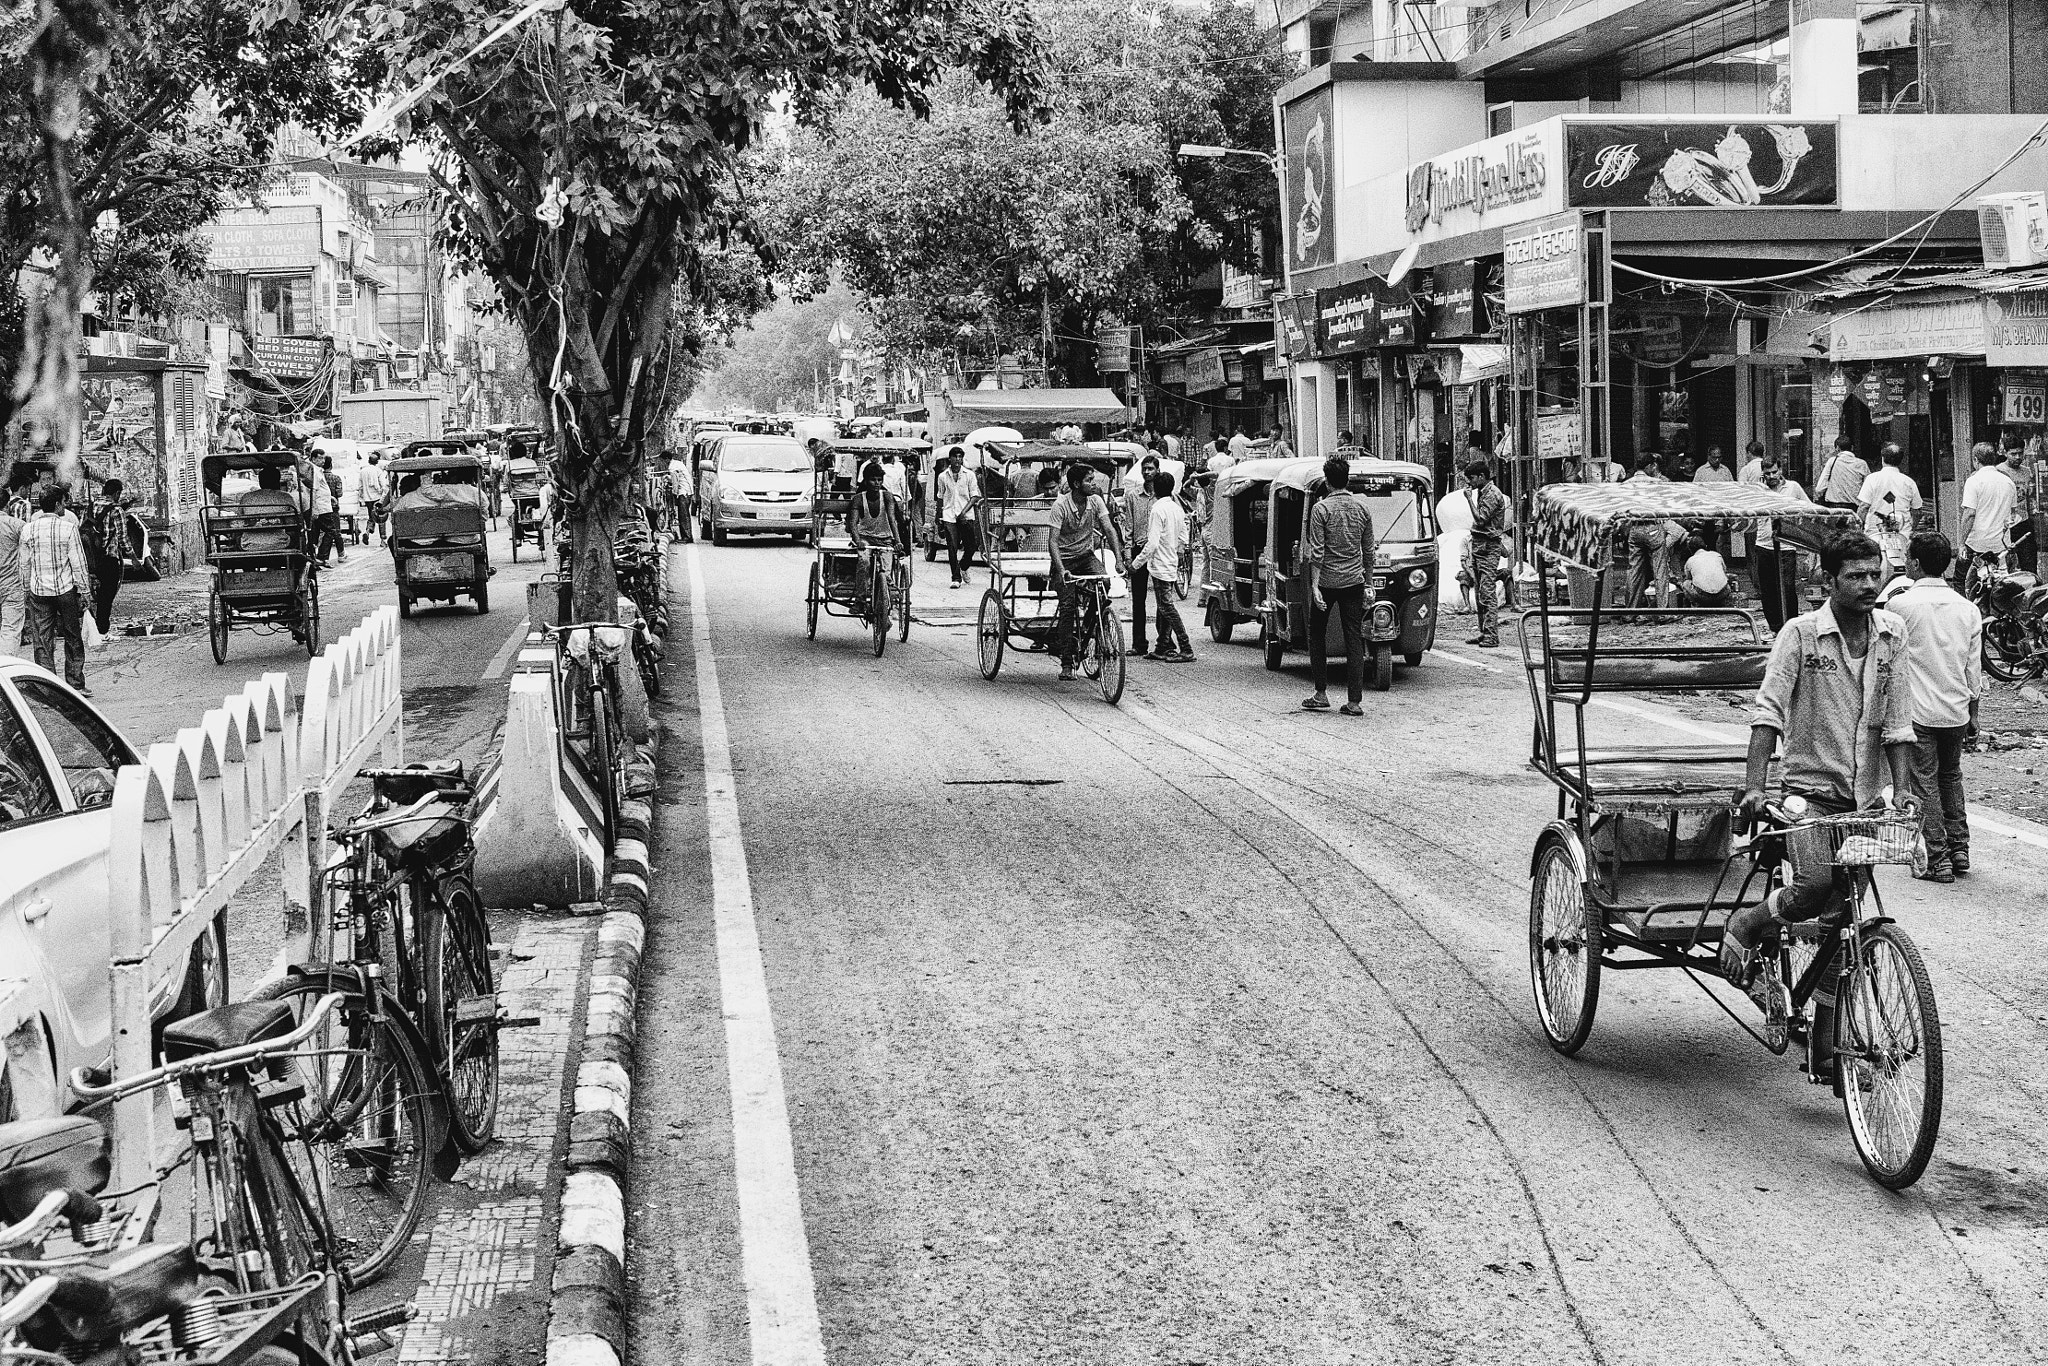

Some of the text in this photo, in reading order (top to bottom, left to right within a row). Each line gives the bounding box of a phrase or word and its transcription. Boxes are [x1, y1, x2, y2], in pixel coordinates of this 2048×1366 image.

[272, 211, 310, 222] SHEETS
[262, 229, 283, 241] SOFA
[286, 227, 315, 241] CLOTH
[244, 245, 252, 256] &
[257, 243, 305, 255] TOWELS
[216, 258, 250, 269] NDAN
[257, 336, 321, 348] BED COVER
[257, 344, 321, 355] BED SHEET
[255, 352, 321, 363] CURTAIN CLOTH
[260, 360, 314, 370] TOWELS
[2013, 395, 2043, 419] 199
